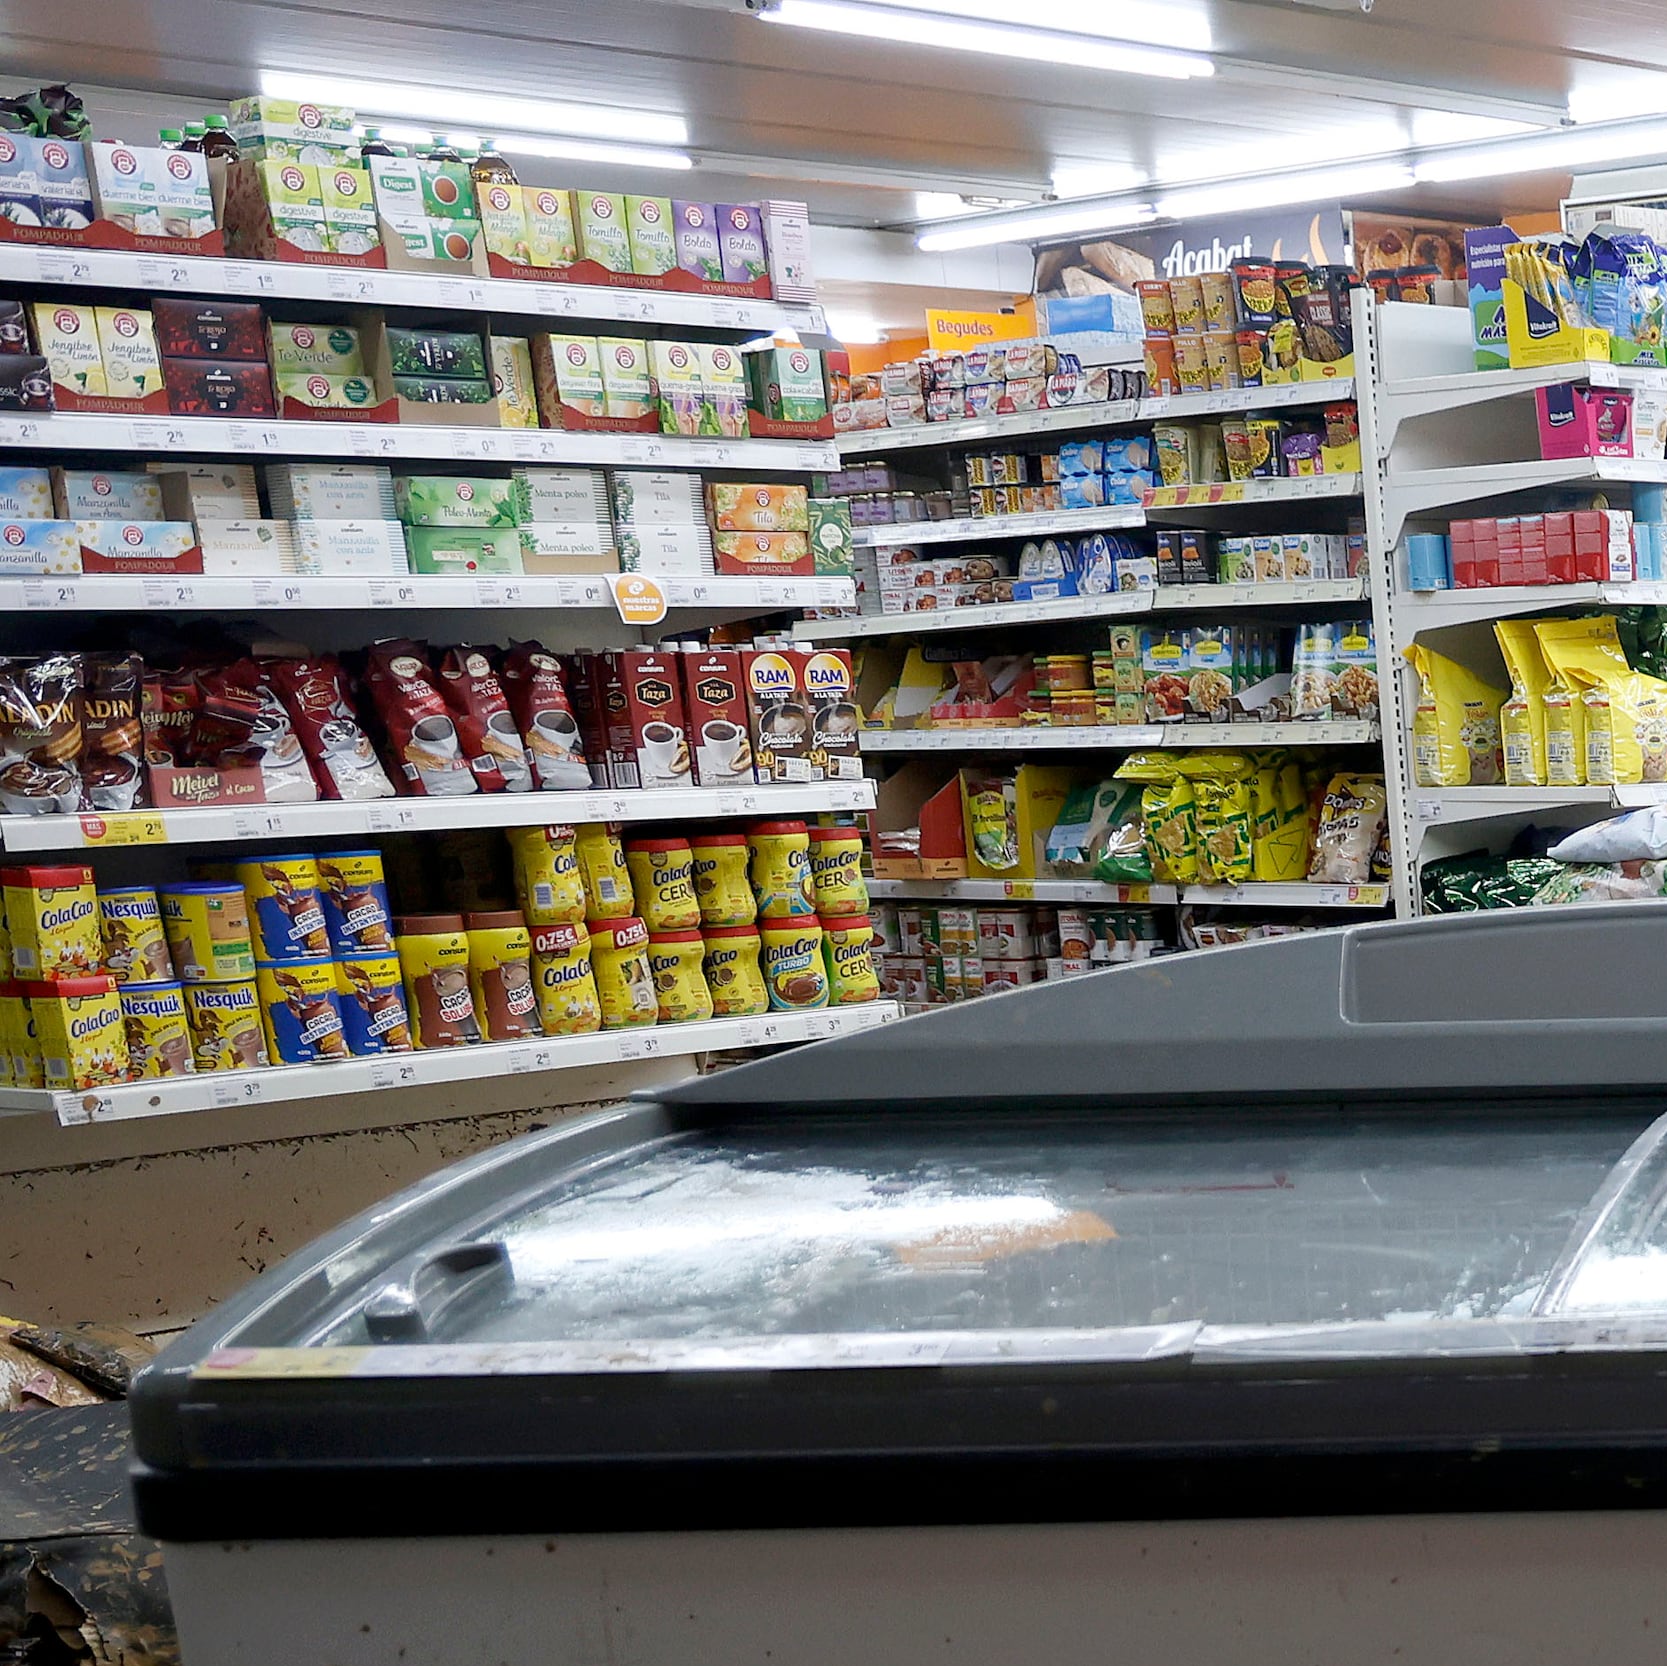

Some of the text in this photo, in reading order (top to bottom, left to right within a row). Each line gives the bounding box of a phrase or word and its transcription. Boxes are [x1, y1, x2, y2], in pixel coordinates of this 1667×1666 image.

[293, 128, 332, 141] digestive
[382, 177, 415, 191] Digest
[280, 205, 318, 219] digestive
[332, 210, 369, 223] digestive
[13, 228, 85, 242] POMPADOUR
[587, 224, 623, 240] Tomillo
[635, 228, 670, 244] Tomillo
[135, 237, 202, 252] POMPADOUR
[684, 235, 712, 250] Boldo
[729, 237, 757, 252] Boldo
[1470, 242, 1501, 256] Especialistas
[304, 254, 367, 266] POMPADOUR
[1471, 258, 1492, 268] nutrición
[511, 266, 569, 281] POMPADOUR
[609, 274, 663, 287] POMPADOUR
[702, 283, 755, 296] POMPADOUR
[935, 318, 994, 338] Begudes
[48, 338, 94, 353] Jengibre
[107, 341, 153, 355] Jengibre
[293, 350, 333, 364] Verde
[1639, 350, 1656, 360] MIX
[76, 398, 145, 413] POMPADOUR
[767, 422, 819, 435] POMPADOUR
[535, 488, 588, 501] Menta poleo
[654, 491, 671, 501] Tila
[76, 496, 131, 510] Manzanilla
[754, 511, 773, 523] Tila
[328, 535, 380, 547] Manzanilla
[108, 546, 163, 558] Manzanilla
[541, 543, 594, 555] Menta poleo
[661, 544, 678, 554] Tila
[0, 550, 48, 565] anzanilla
[115, 560, 176, 571] POMPADOUR
[747, 564, 793, 573] POMPADOUR
[623, 596, 659, 606] nuestras
[624, 604, 657, 612] marcas
[754, 668, 790, 685] RAM
[809, 668, 844, 684] RAM
[642, 687, 669, 702] Taza
[702, 687, 731, 701] Taza
[757, 733, 803, 749] Chocolate
[811, 733, 856, 748] Chocolate
[811, 851, 859, 873] ColaCao
[288, 872, 314, 880] consum
[40, 901, 94, 929] ColaCao
[101, 898, 159, 919] Nesquik
[348, 906, 377, 920] CACAO
[295, 911, 320, 926] CACAO
[439, 946, 468, 956] consum
[766, 939, 818, 963] ColaCao
[778, 956, 811, 972] TURBO
[369, 971, 397, 980] consum
[122, 995, 181, 1016] Nesquik
[195, 991, 254, 1009] Nesquik
[306, 1012, 334, 1029] CACAO
[374, 1006, 403, 1022] CACAO
[70, 1006, 120, 1038] ColaCao
